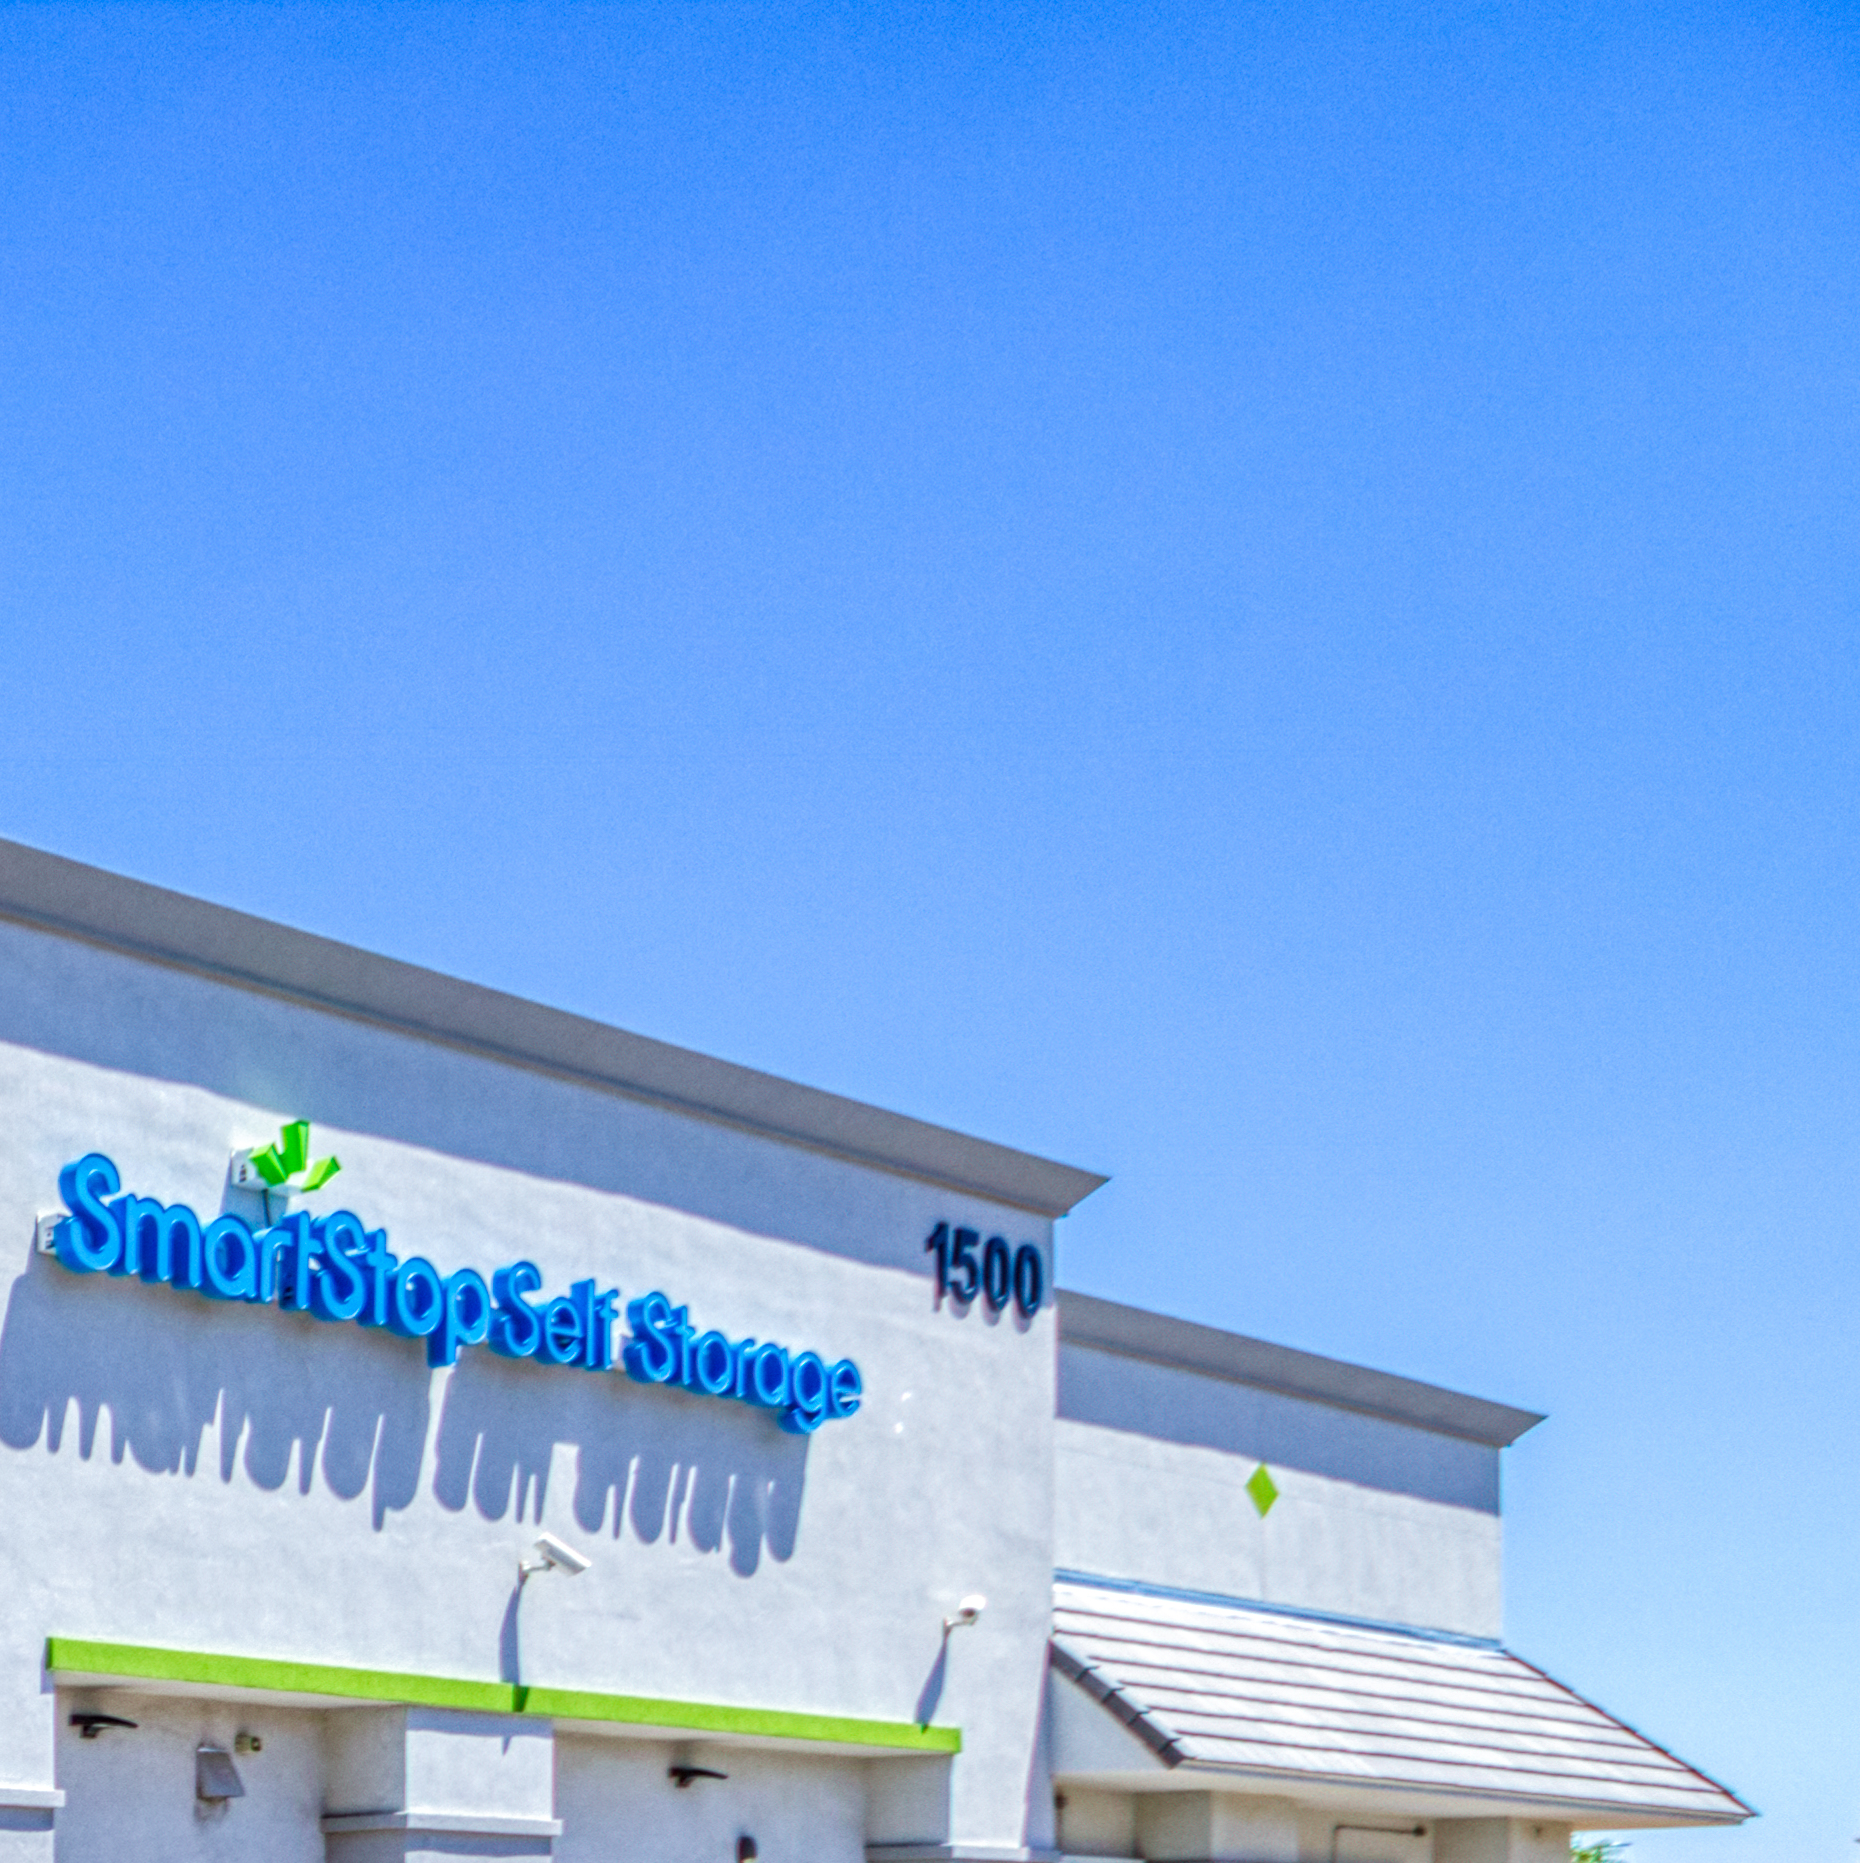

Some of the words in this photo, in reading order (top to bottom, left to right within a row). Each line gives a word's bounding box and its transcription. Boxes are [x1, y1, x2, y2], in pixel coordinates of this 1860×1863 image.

[55, 1152, 490, 1368] SmartStop
[488, 1260, 620, 1371] Self
[623, 1291, 863, 1434] Storage
[925, 1221, 1043, 1319] 1500
